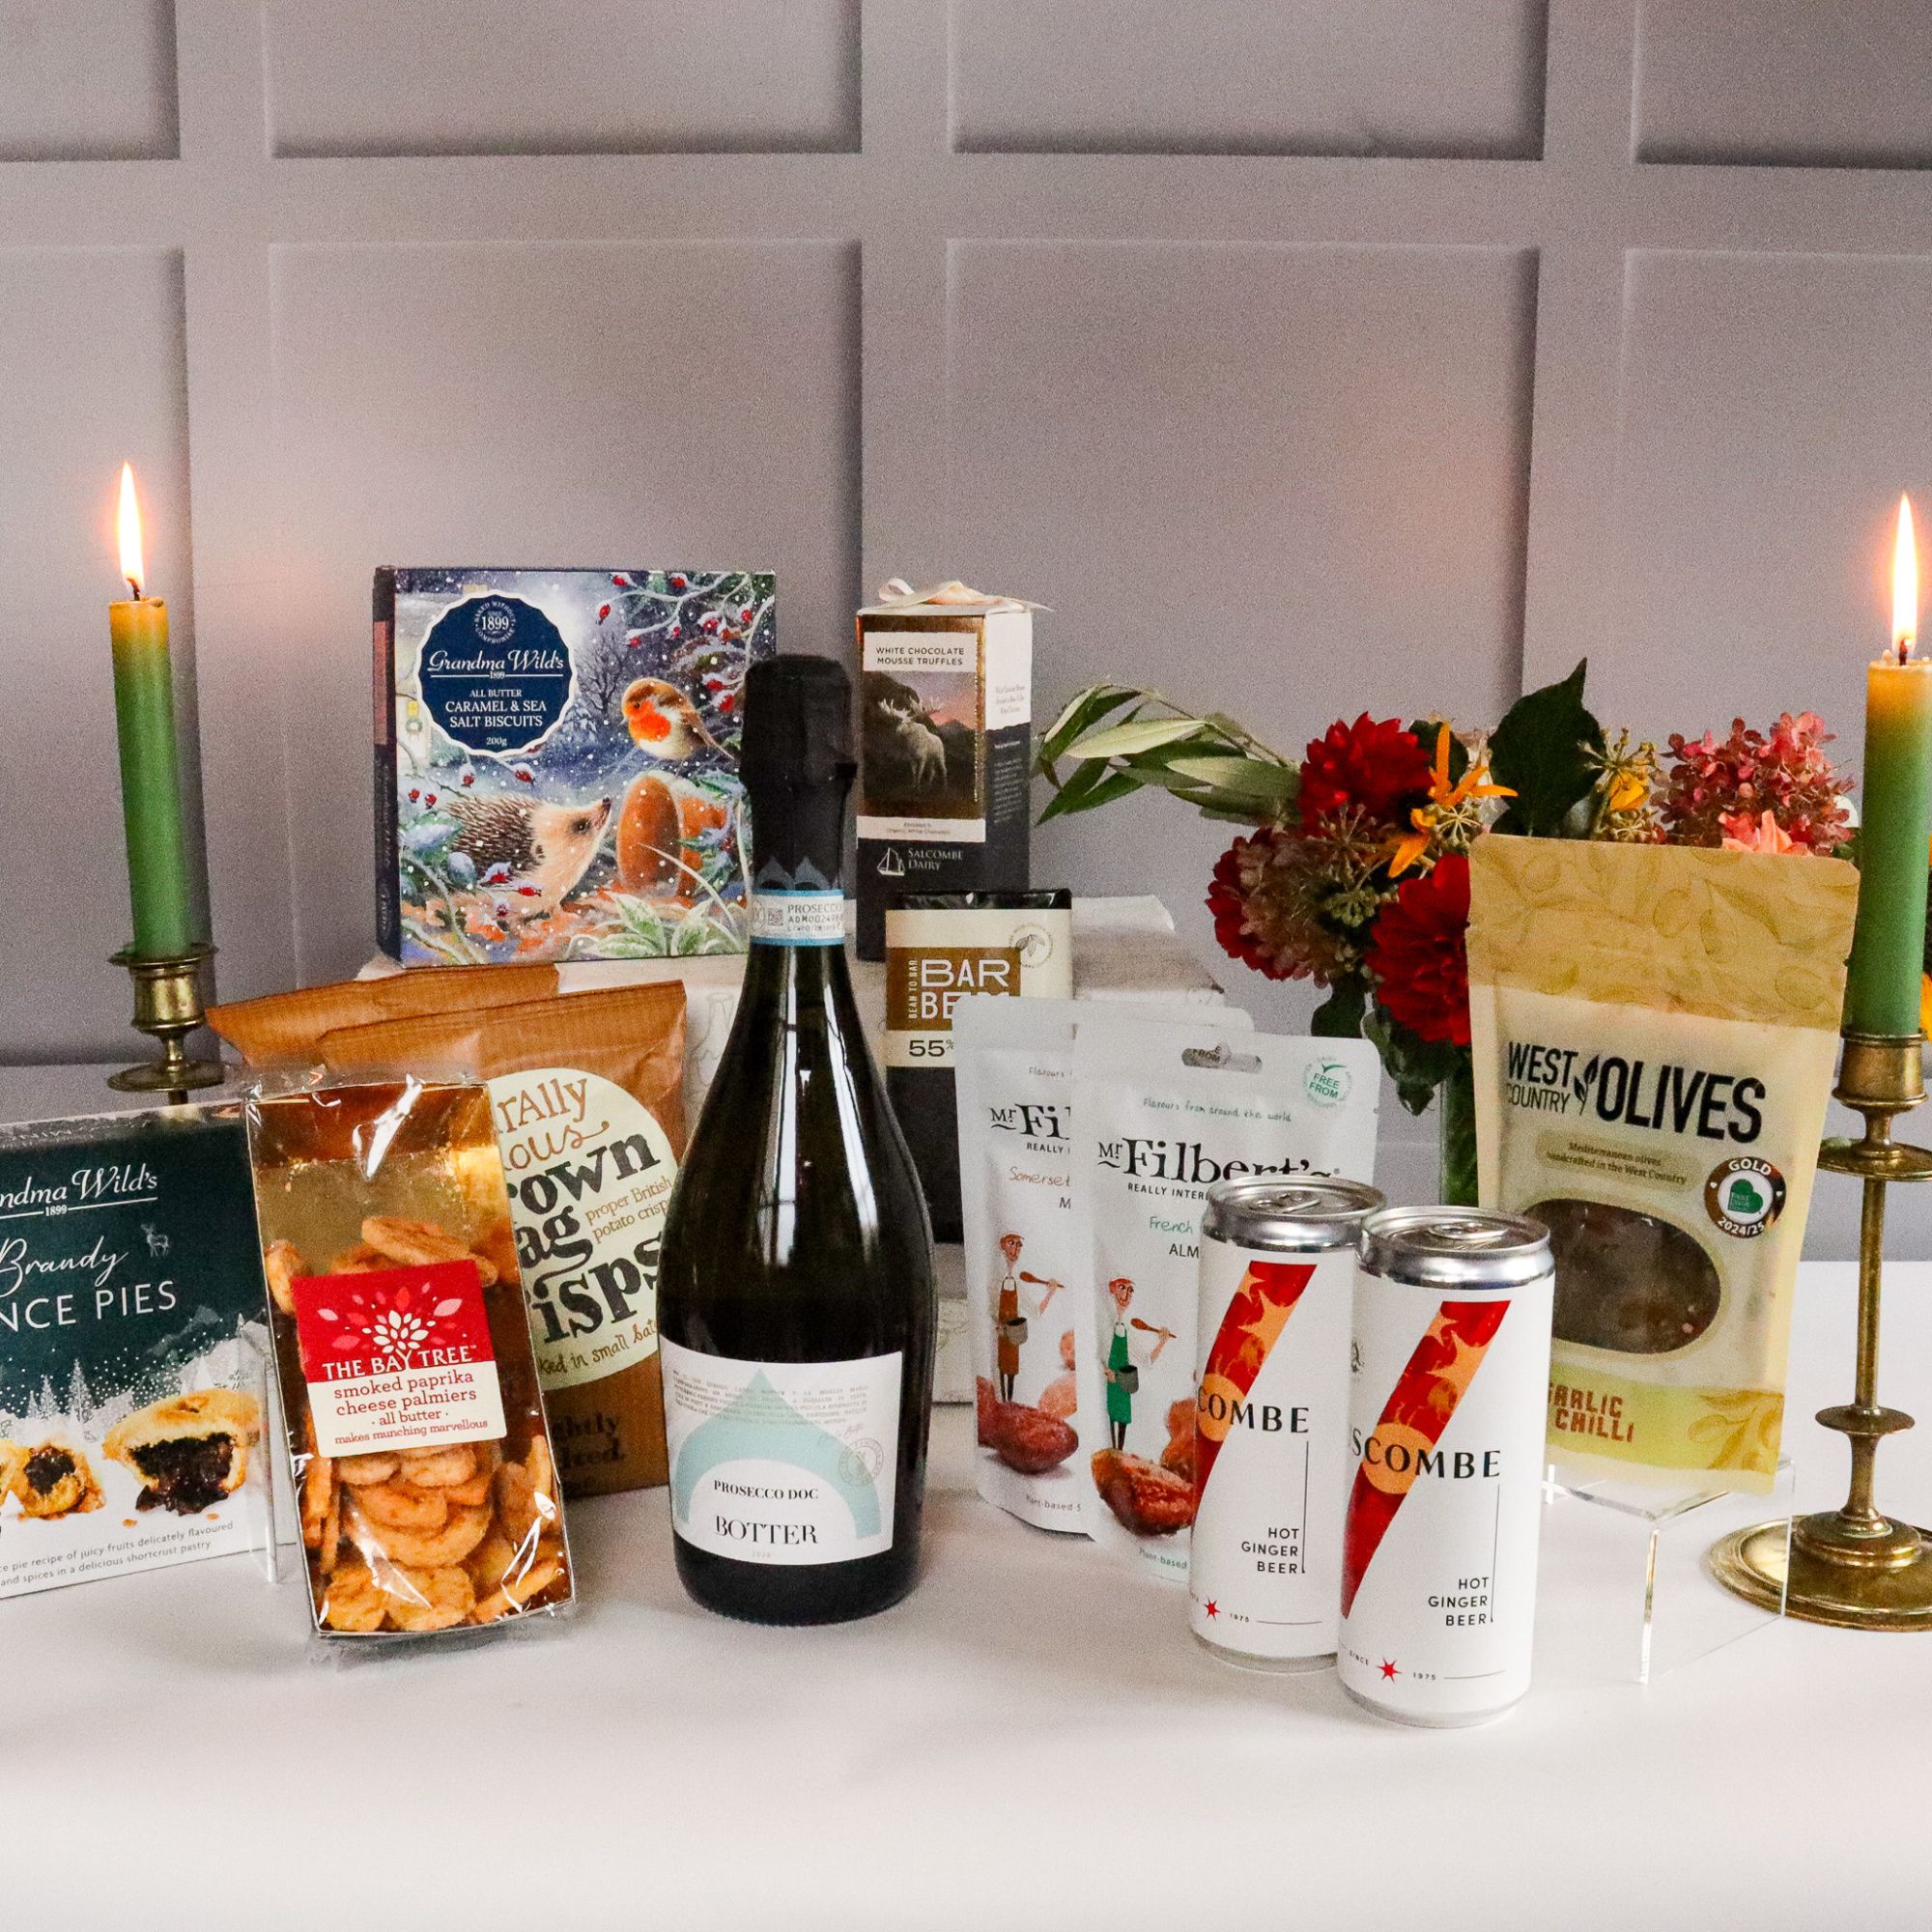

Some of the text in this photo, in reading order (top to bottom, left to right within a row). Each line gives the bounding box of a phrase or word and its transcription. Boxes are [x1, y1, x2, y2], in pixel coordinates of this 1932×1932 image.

[482, 615, 509, 631] 1899
[427, 649, 564, 671] Grandma Wild's
[876, 646, 964, 656] WHITE CHOCOLATE
[877, 657, 914, 666] MOUSSE
[489, 670, 506, 679] 1899
[469, 689, 522, 697] ALL BUTTER
[445, 700, 547, 712] CARAMEL & SEA
[449, 715, 543, 727] SALT BISCUITS
[486, 736, 507, 747] 200g
[909, 860, 941, 870] DAIRY
[921, 958, 1010, 987] BAR
[908, 959, 918, 1019] BEAN TO BAR
[1309, 1082, 1339, 1098] FROM
[1314, 1072, 1340, 1089] FREE
[1506, 1082, 1571, 1114] COUNTRY
[1508, 1041, 1766, 1144] WEST OLIVES
[1027, 1143, 1064, 1153] REALLY
[506, 1133, 661, 1215] own
[1009, 1166, 1070, 1187] Somerset
[1729, 1158, 1772, 1176] GOLD
[71, 1162, 158, 1201] Wild's
[1127, 1181, 1208, 1201] REALLY INTER
[584, 1175, 672, 1225] proper British
[44, 1205, 68, 1217] 1899
[592, 1214, 635, 1244] potato
[1150, 1215, 1193, 1235] French
[1718, 1216, 1765, 1236] 2024/25
[0, 1236, 128, 1298] Brandy
[96, 1280, 177, 1321] PIES
[571, 1352, 588, 1369] in
[592, 1334, 630, 1363] small
[322, 1359, 365, 1380] THE
[371, 1349, 412, 1374] BAY
[334, 1369, 474, 1400] smoked paprika
[336, 1388, 477, 1417] cheese palmiers
[379, 1408, 441, 1427] all butter
[1554, 1407, 1634, 1442] CHILLI
[334, 1418, 488, 1445] makes munching marvellous
[714, 1479, 819, 1500] PROSECCO DOC
[715, 1515, 819, 1546] BOTTER
[1267, 1527, 1299, 1541] HOT
[12, 1561, 28, 1572] pie
[31, 1553, 63, 1567] recipe
[66, 1548, 77, 1560] of
[80, 1547, 104, 1559] juicy
[107, 1540, 134, 1551] fruits
[137, 1530, 185, 1548] delicately
[188, 1520, 233, 1538] flavoured
[1241, 1541, 1298, 1557] GINGER
[23, 1570, 54, 1583] spices
[57, 1568, 66, 1577] in
[79, 1556, 124, 1573] delicious
[127, 1545, 177, 1562] shortcrust
[181, 1541, 211, 1554] pastry
[1257, 1560, 1297, 1575] BEER
[1459, 1577, 1490, 1590] HOT
[1428, 1595, 1488, 1608] GINGER
[1445, 1613, 1487, 1627] BEER
